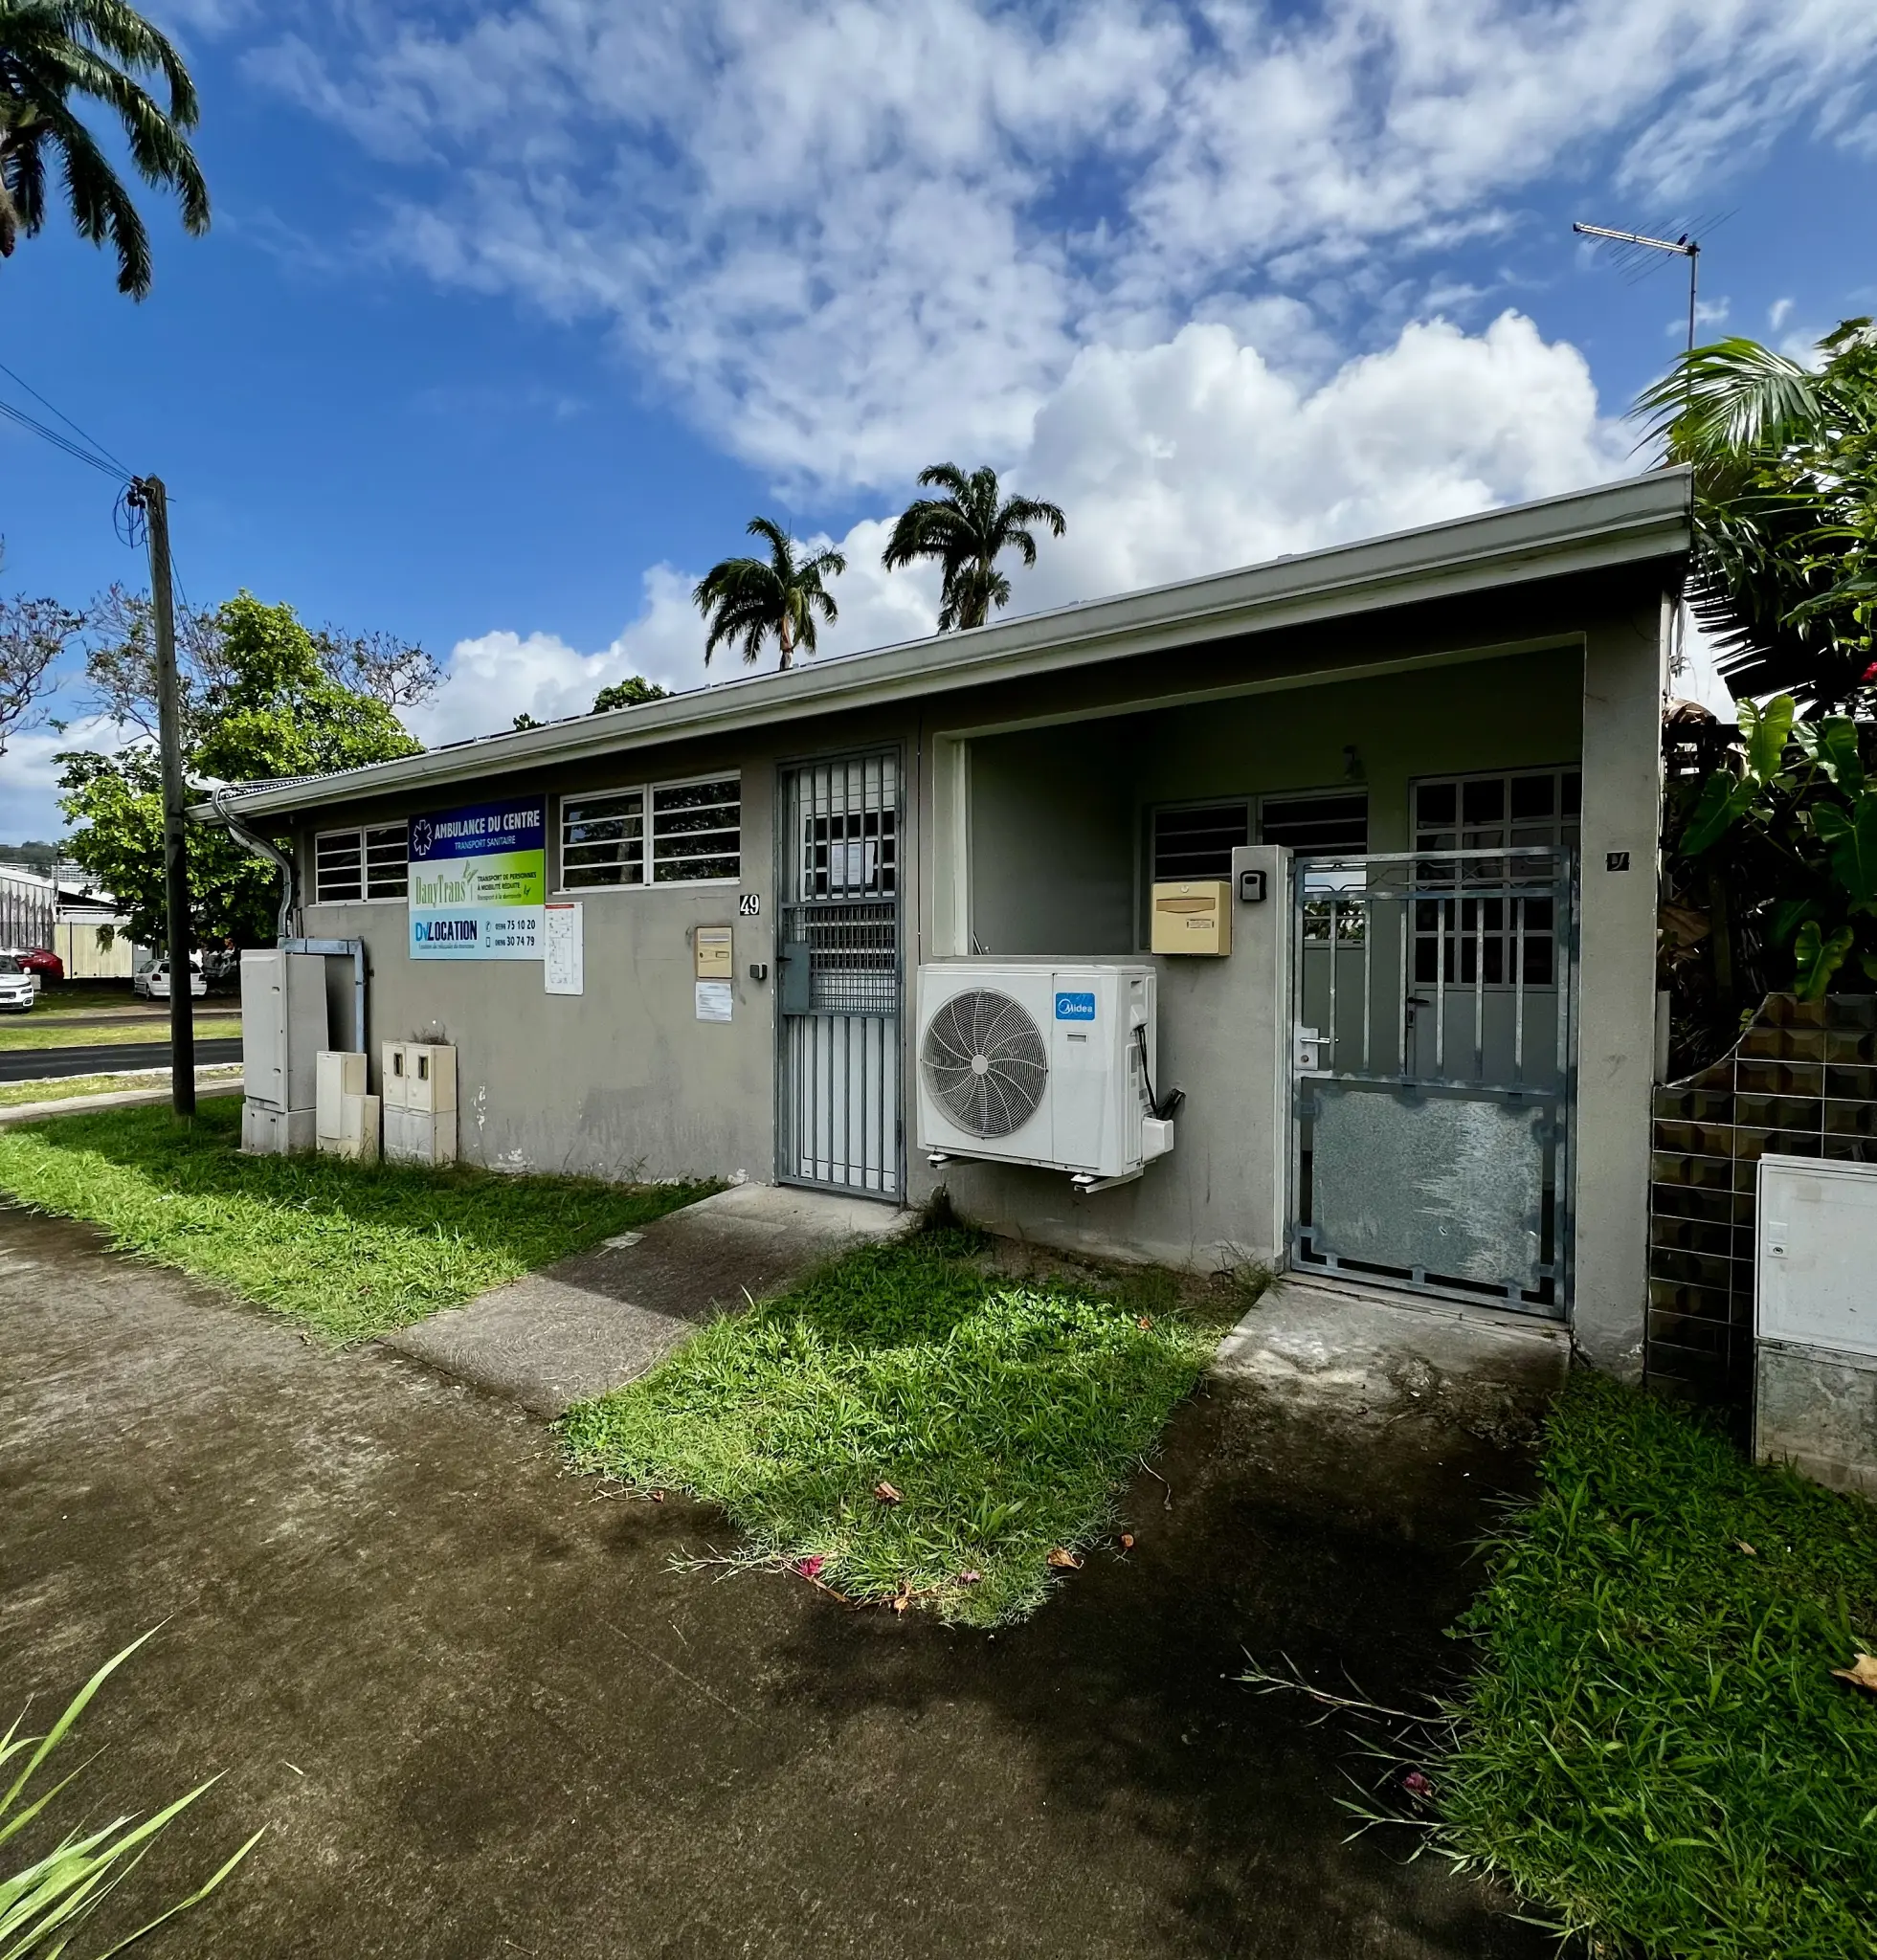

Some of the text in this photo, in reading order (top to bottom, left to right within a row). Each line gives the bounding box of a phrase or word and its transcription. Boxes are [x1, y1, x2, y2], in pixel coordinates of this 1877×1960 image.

[435, 810, 540, 839] AMBULANCE DU CENTRE
[455, 835, 516, 850] TRANSPORT SANITAIRE
[477, 874, 503, 882] TRANSPORT
[509, 871, 536, 880] PERSONNES
[415, 875, 466, 908] DanyTrans
[740, 895, 760, 915] 49
[507, 920, 515, 930] 75
[517, 920, 525, 930] 10
[526, 919, 536, 930] 20
[506, 936, 515, 947] 30
[516, 936, 525, 947] 74
[526, 936, 535, 947] 79
[1063, 1002, 1093, 1013] Midea
